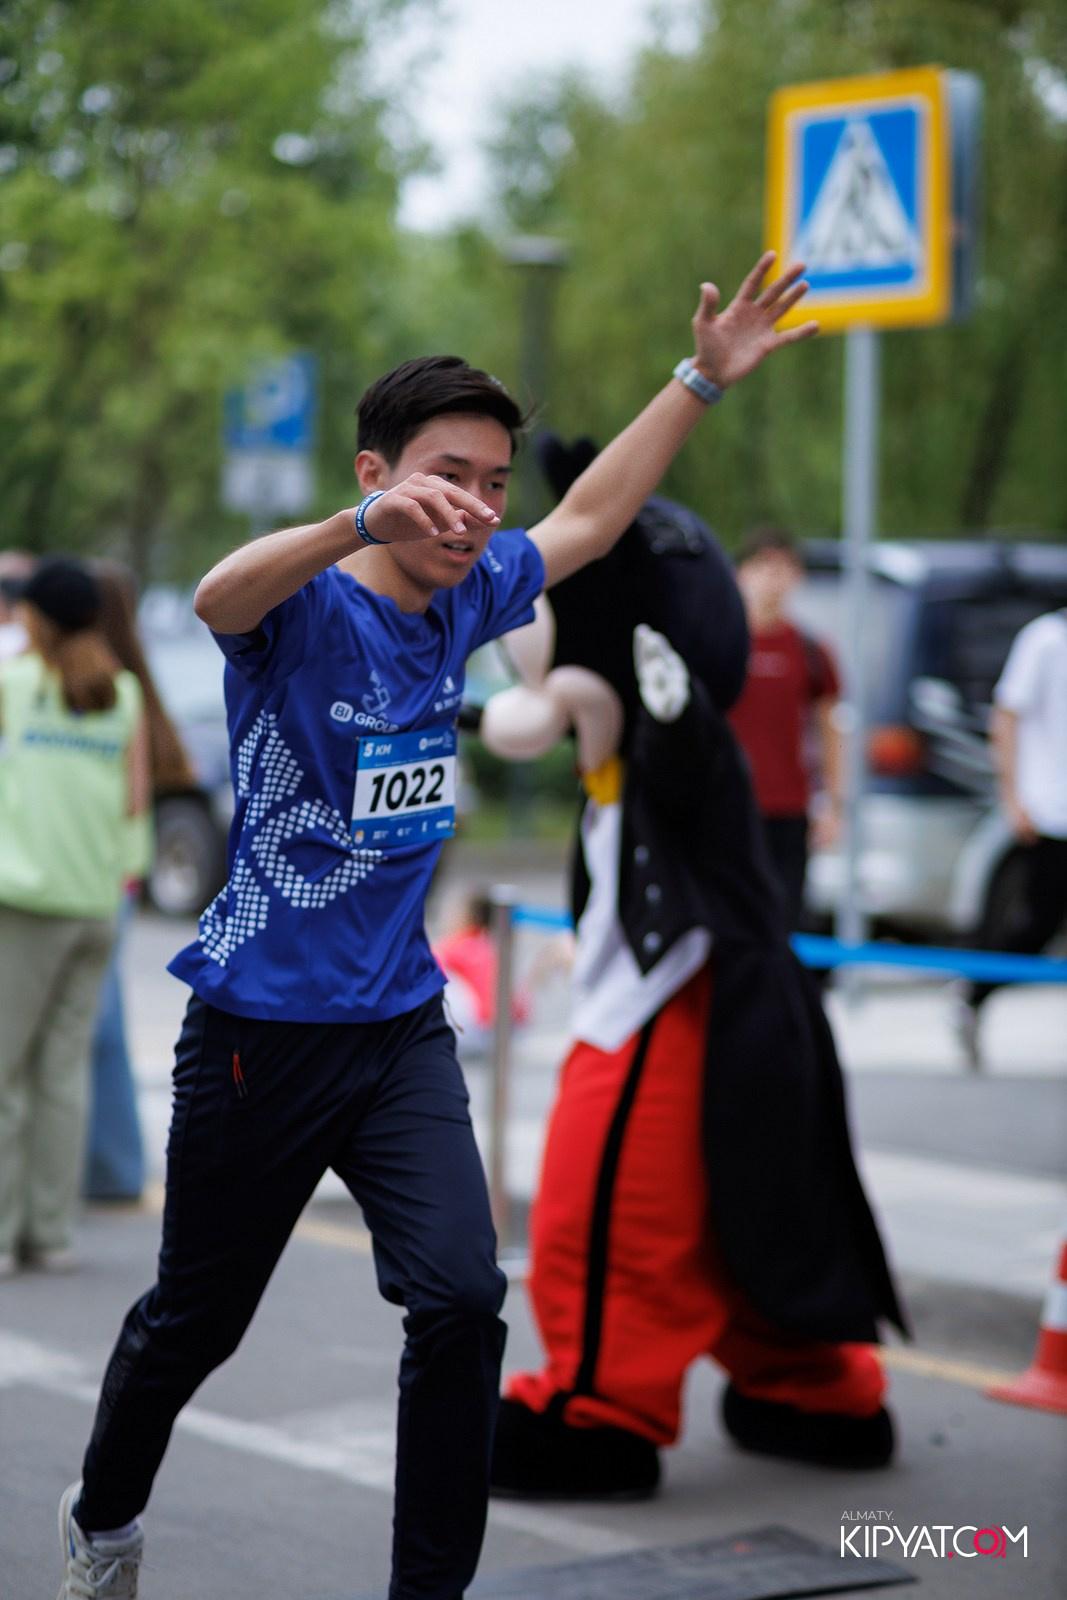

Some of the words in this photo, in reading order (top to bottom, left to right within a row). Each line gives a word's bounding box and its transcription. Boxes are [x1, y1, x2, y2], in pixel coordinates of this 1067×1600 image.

[334, 704, 349, 718] BI
[354, 712, 399, 732] GROUP
[363, 743, 374, 757] 5
[375, 744, 392, 756] KM
[369, 764, 445, 812] 1022
